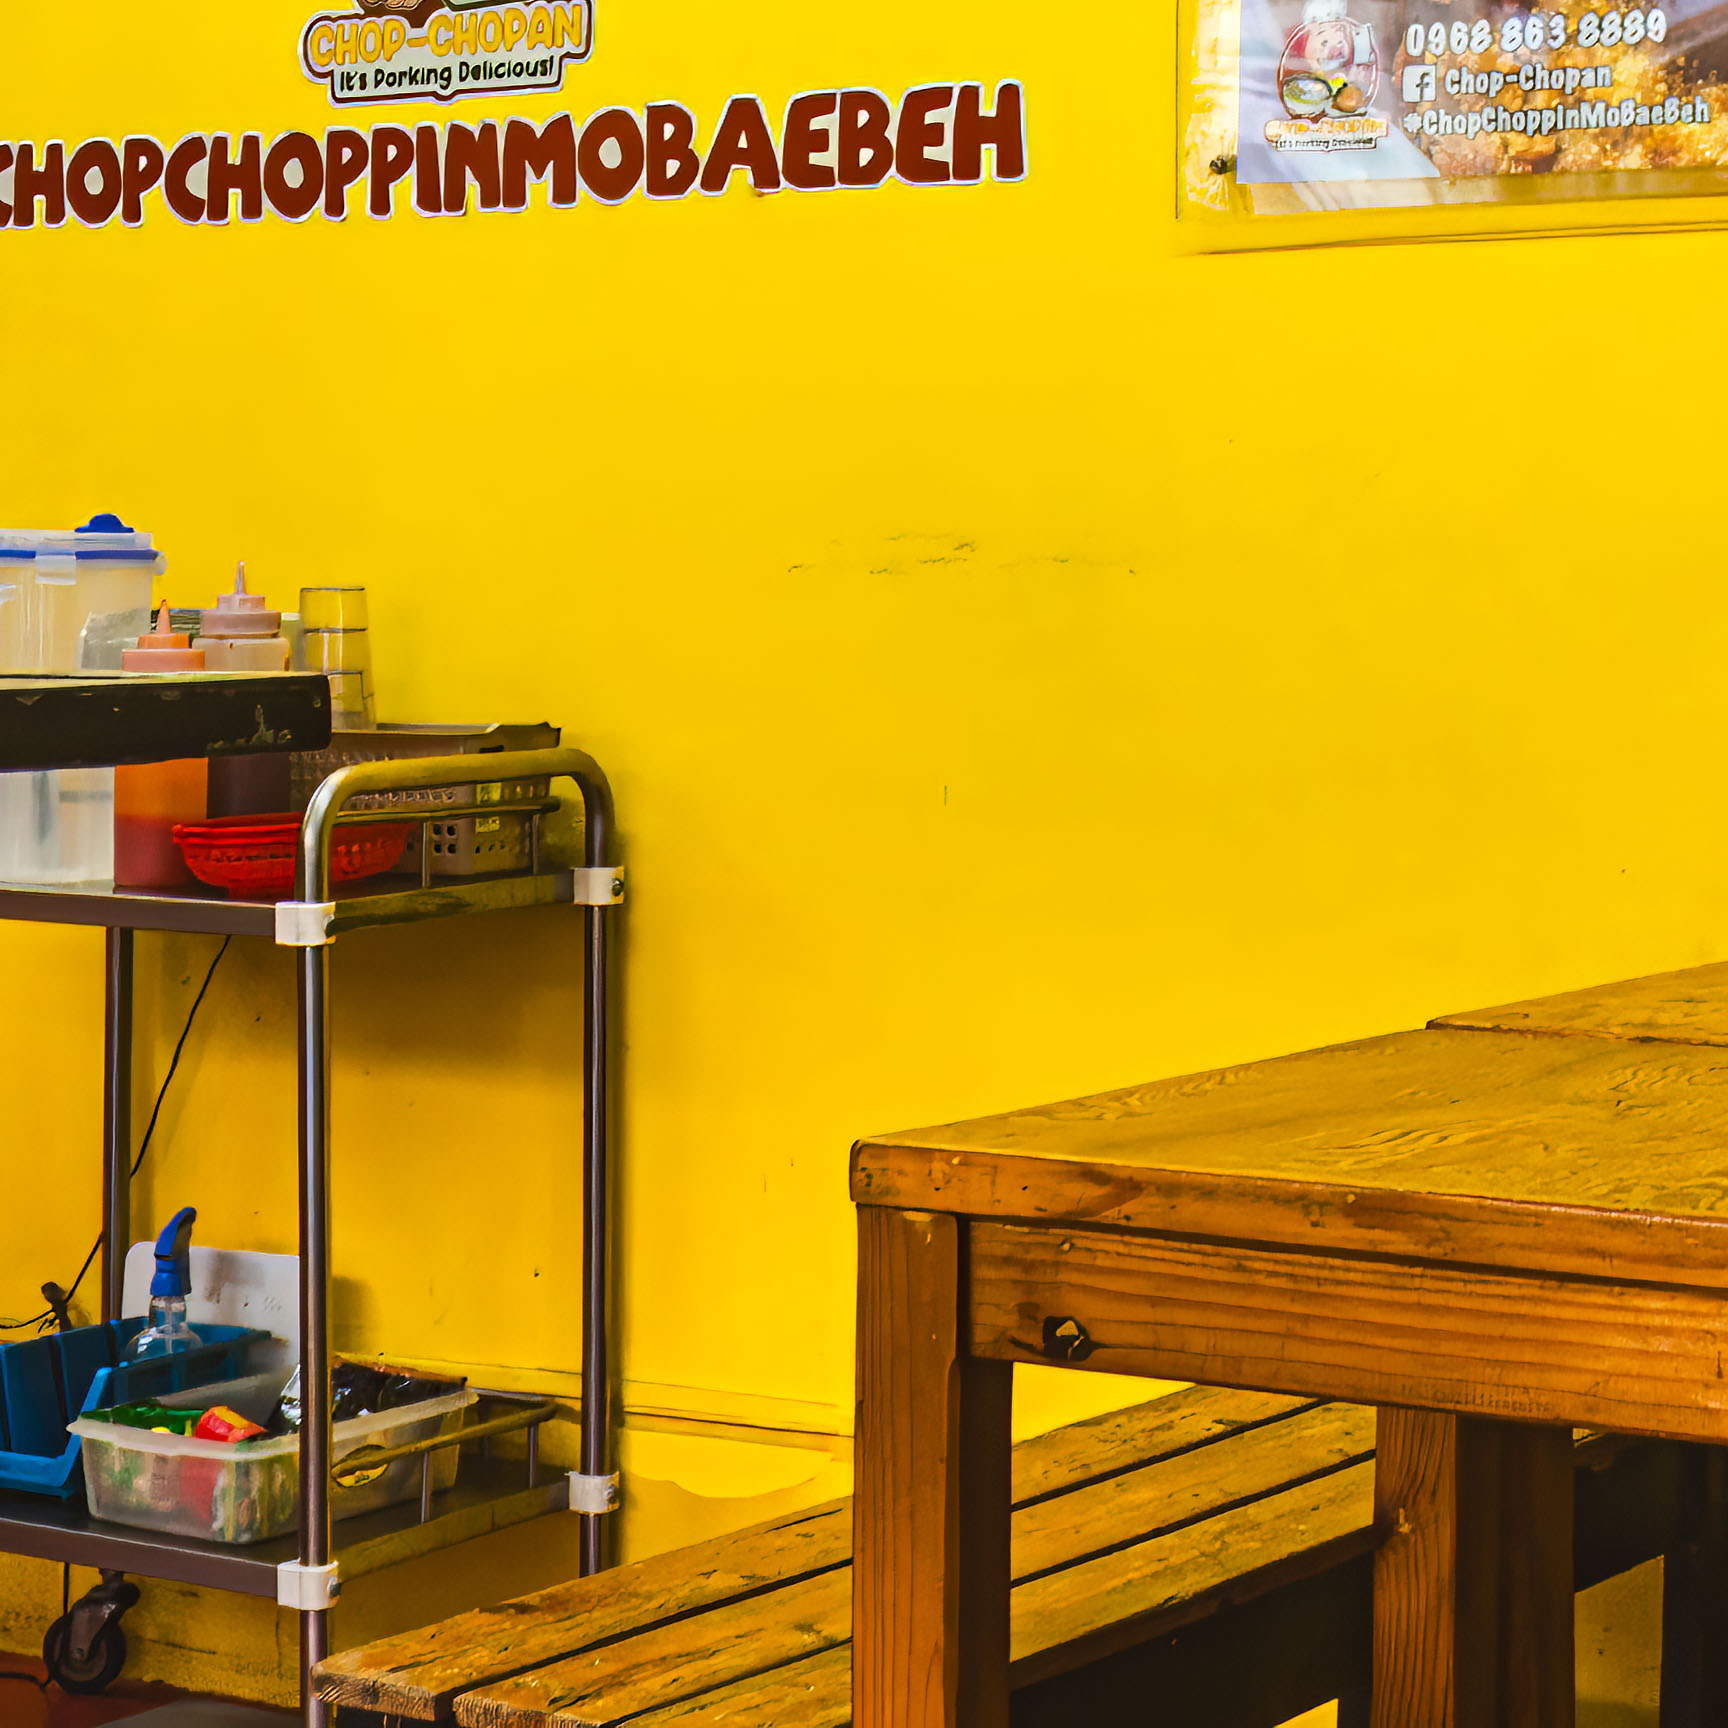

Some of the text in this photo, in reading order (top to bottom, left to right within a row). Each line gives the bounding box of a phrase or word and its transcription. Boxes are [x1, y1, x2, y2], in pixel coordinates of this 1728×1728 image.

[310, 3, 583, 66] CHOP-CHOPAN
[1405, 9, 1668, 56] 0968 863 8889
[340, 55, 554, 92] It's Porking Delicious!
[1445, 65, 1611, 96] Chop-Chopan
